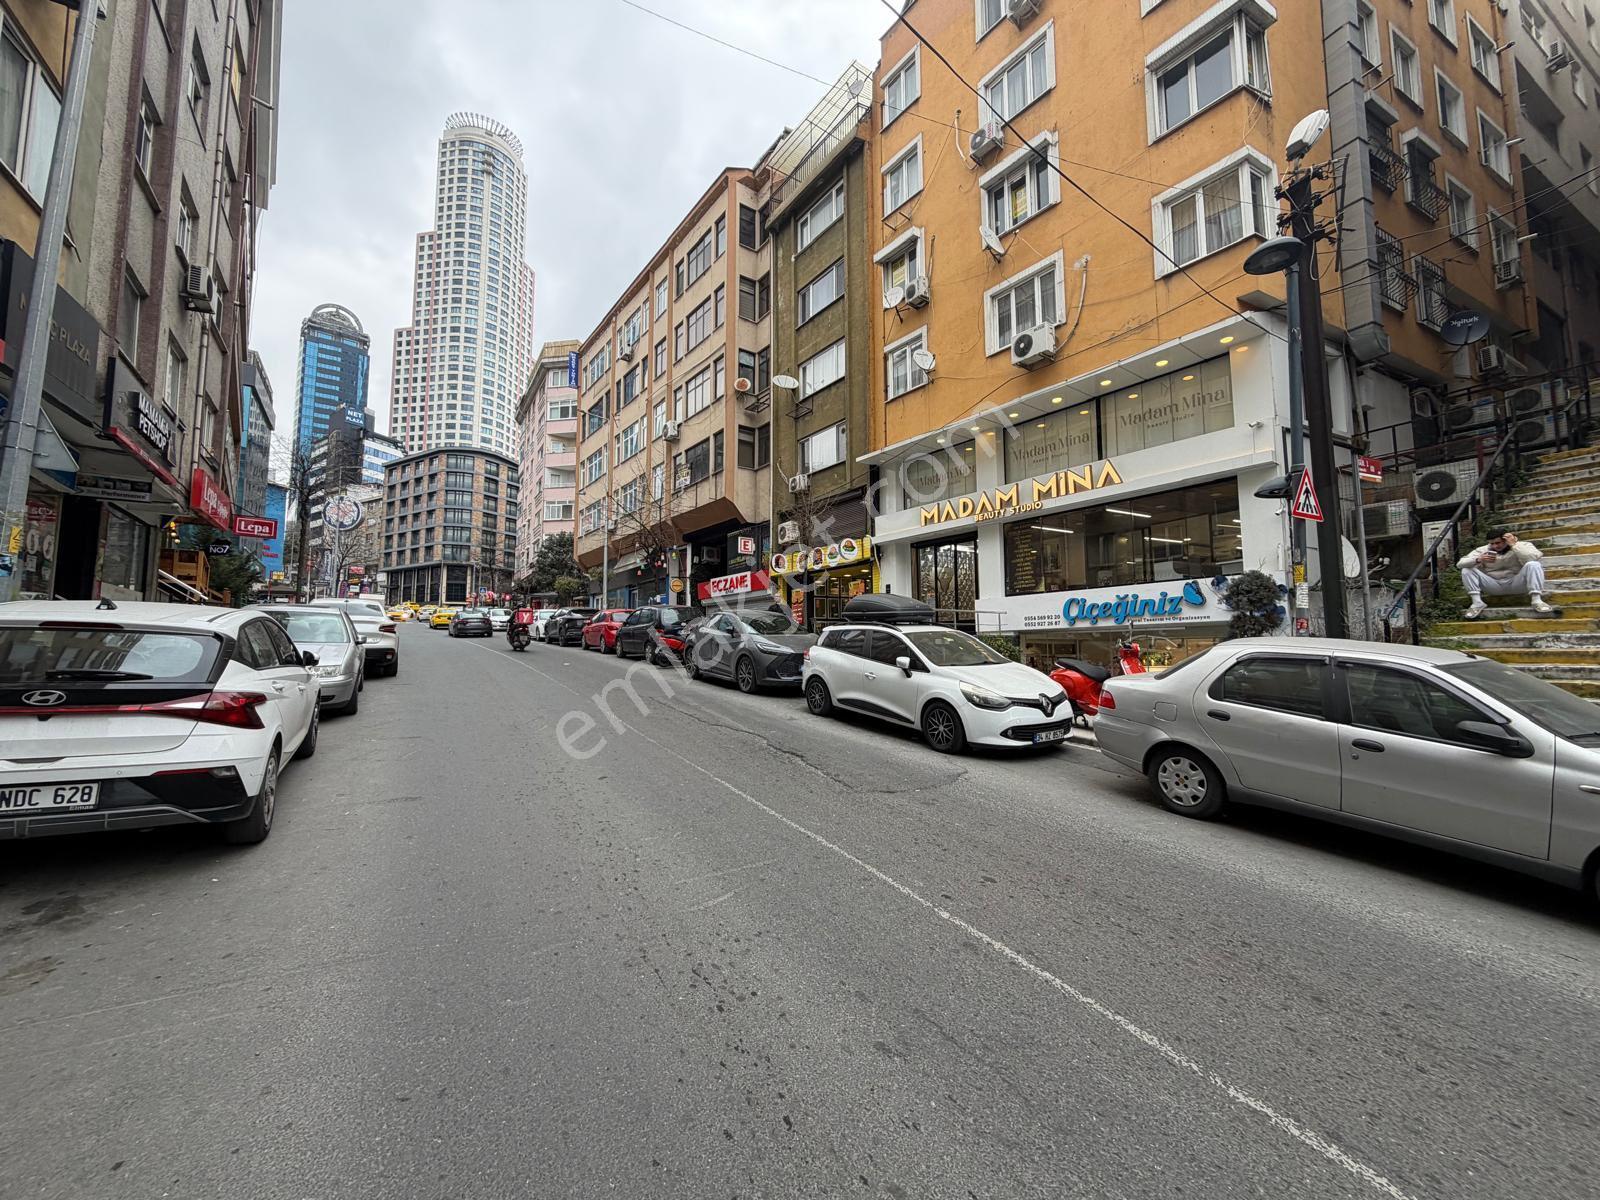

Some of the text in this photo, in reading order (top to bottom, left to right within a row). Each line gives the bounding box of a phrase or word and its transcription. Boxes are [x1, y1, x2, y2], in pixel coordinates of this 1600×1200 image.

[347, 410, 362, 418] NET
[1120, 389, 1225, 428] Madam Mina
[139, 413, 167, 450] PETSHOP
[345, 416, 364, 425] PLAZA
[1012, 432, 1090, 464] Madam Mina
[920, 484, 1019, 527] MADAM
[974, 501, 1042, 522] BEAUTY STUDIO
[240, 521, 269, 536] Lepa
[743, 540, 750, 550] E
[711, 574, 749, 593] ECZANE
[1063, 592, 1183, 626] Çiçeğiniz
[0, 785, 94, 809] NDC 628
